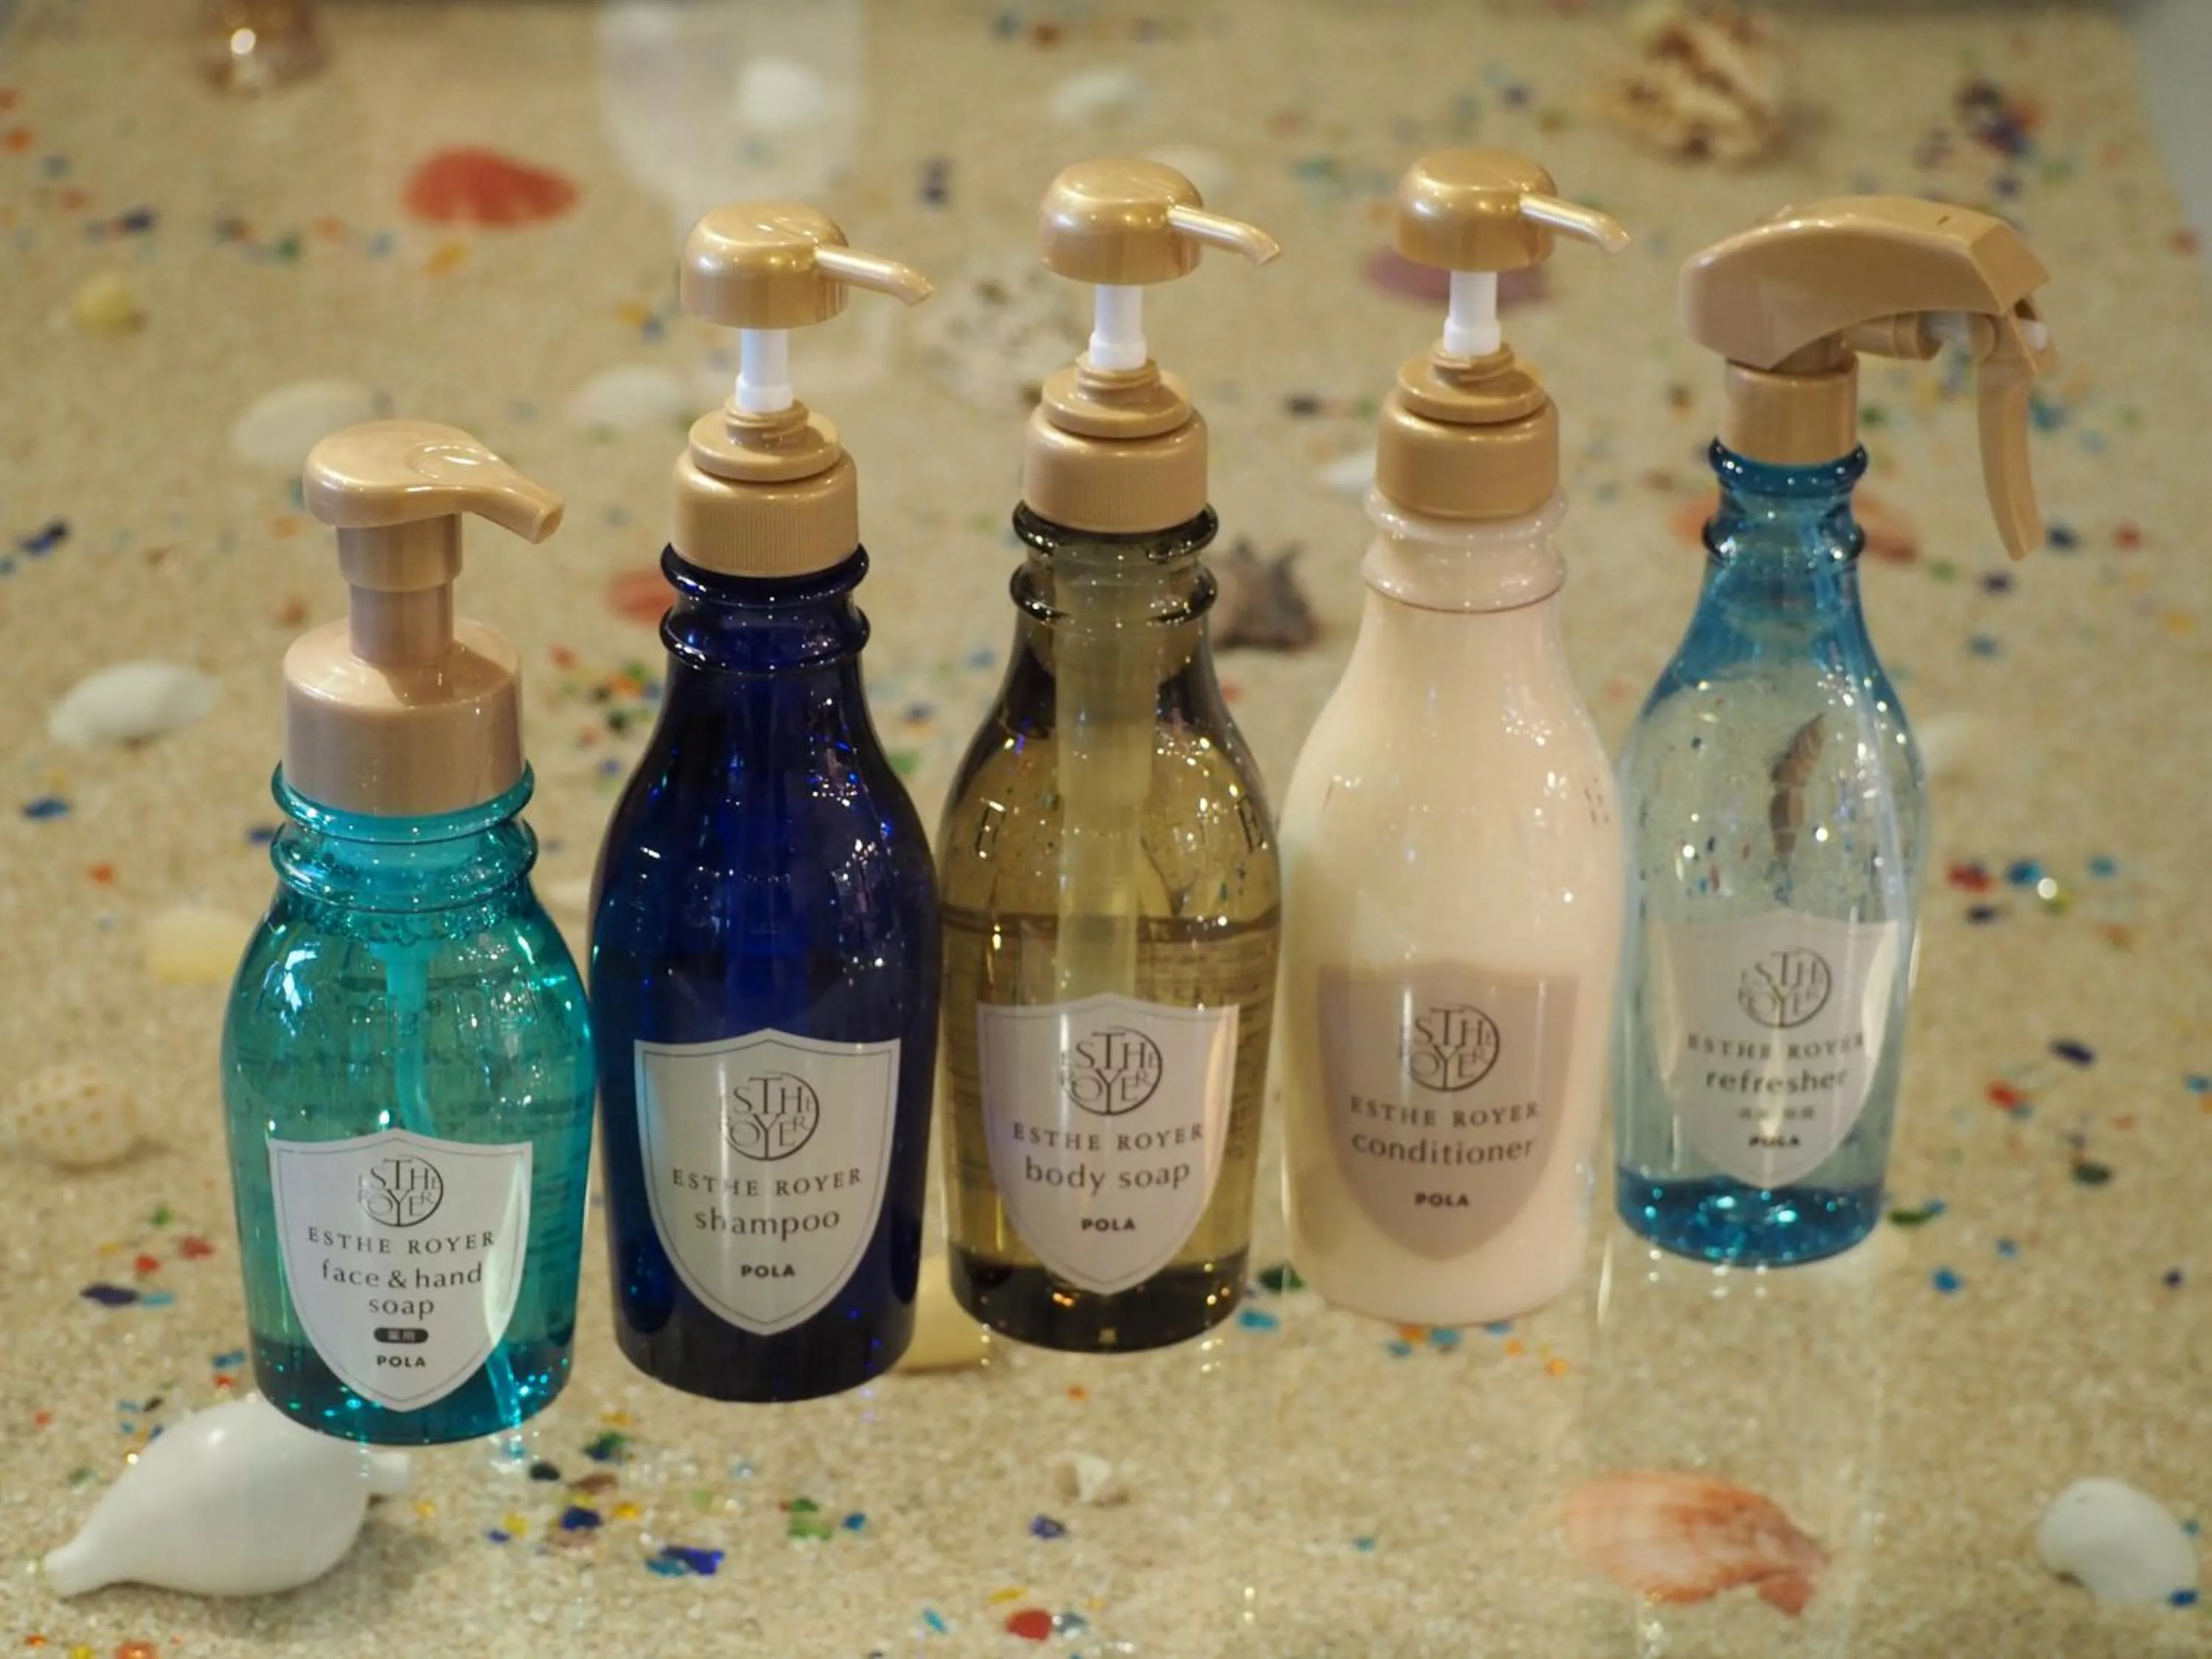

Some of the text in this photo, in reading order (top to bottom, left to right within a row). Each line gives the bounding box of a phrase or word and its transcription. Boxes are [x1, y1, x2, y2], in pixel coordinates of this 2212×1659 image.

[1705, 1069, 1848, 1094] refresher
[1350, 1096, 1538, 1127] ESTHE ROYER
[1013, 1121, 1203, 1152] ESTHE ROYER
[1351, 1133, 1537, 1166] conditioner
[672, 1167, 861, 1197] ESTHE ROYER
[1026, 1155, 1190, 1197] body soap
[1414, 1192, 1470, 1208] POLA
[695, 1206, 840, 1242] shampoo
[1082, 1218, 1136, 1231] POLA
[307, 1226, 495, 1254] ESTHE ROYER
[321, 1259, 482, 1289] face & hand
[741, 1265, 796, 1279] POLA
[369, 1298, 434, 1320] soap
[376, 1354, 425, 1368] POLA
